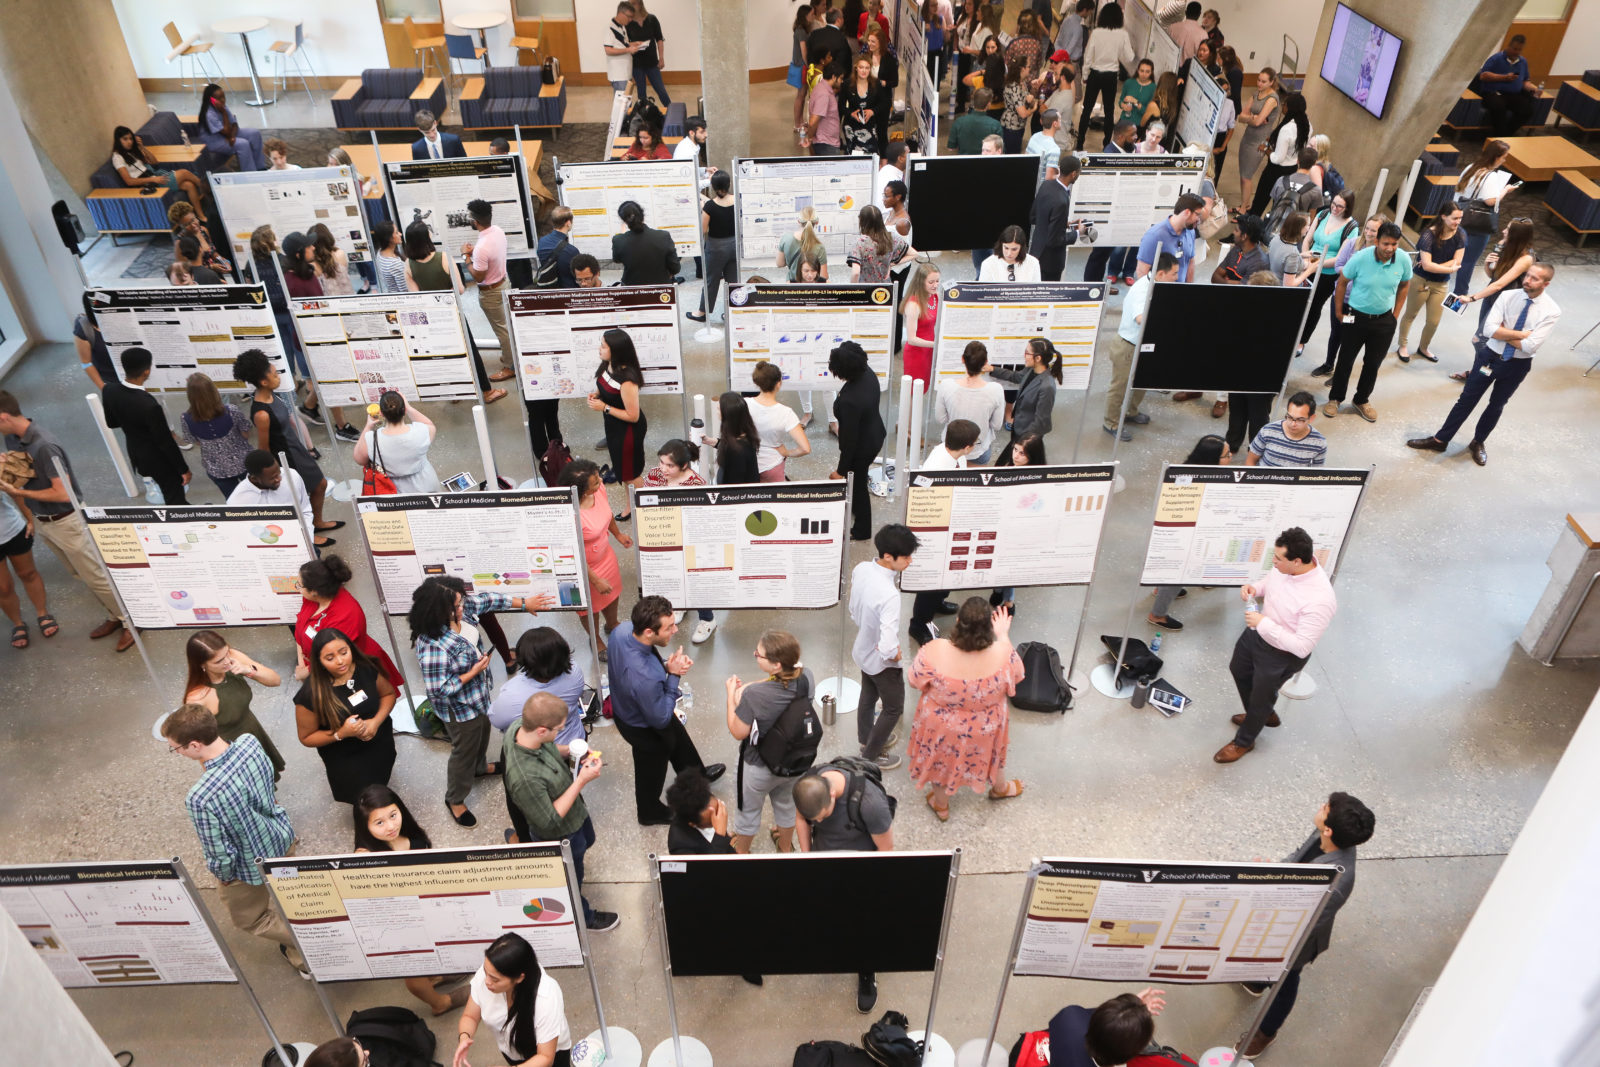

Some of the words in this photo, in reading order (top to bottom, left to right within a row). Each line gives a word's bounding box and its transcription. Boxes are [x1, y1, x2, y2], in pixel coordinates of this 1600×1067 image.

[393, 870, 435, 878] insurance
[463, 865, 512, 874] adjustment
[277, 882, 332, 891] Classification
[294, 908, 337, 917] Rejections
